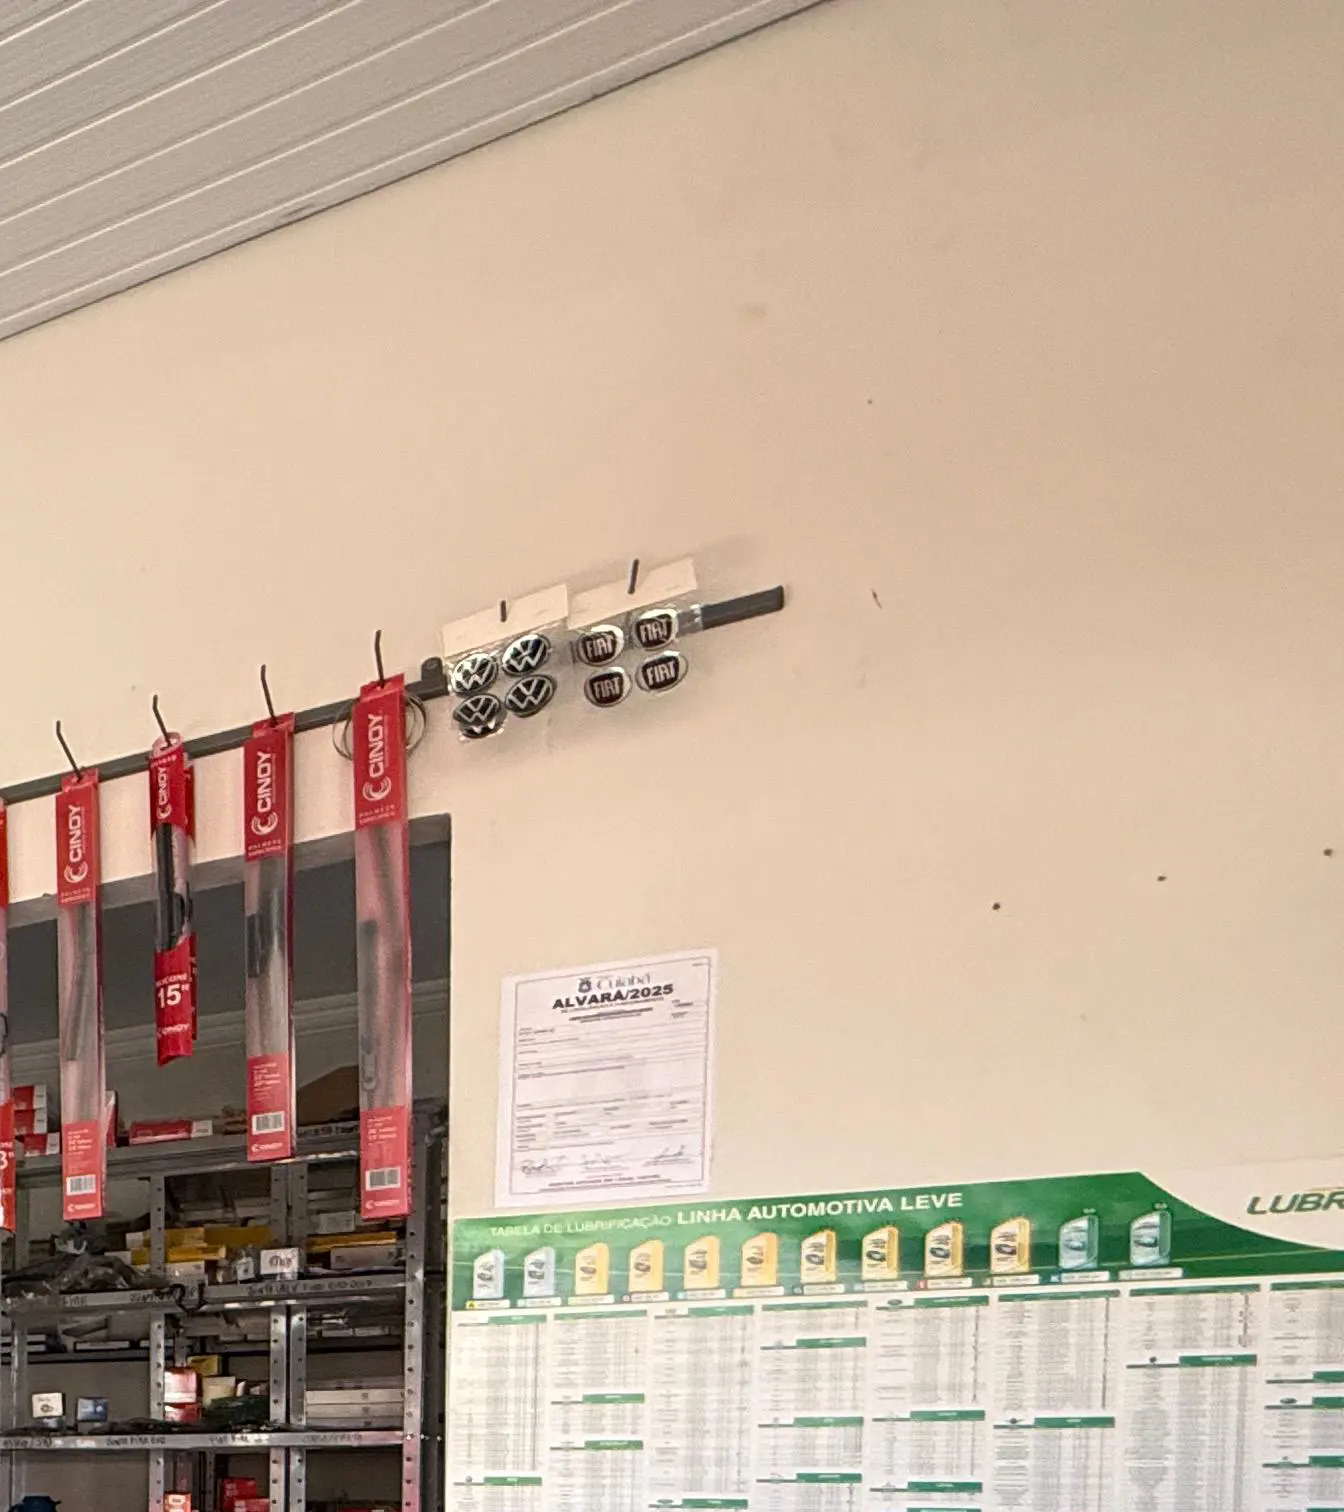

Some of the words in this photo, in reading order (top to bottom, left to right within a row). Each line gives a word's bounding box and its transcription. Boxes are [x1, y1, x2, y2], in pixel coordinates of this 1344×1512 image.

[585, 634, 615, 660] FIAT
[639, 618, 672, 643] FIAT
[593, 677, 621, 700] FIAT
[645, 662, 680, 686] FIAT
[368, 714, 385, 778] CINDY
[256, 751, 273, 813] CINDY
[69, 804, 83, 862] CINDY
[490, 1222, 540, 1236] TABELA
[544, 1223, 564, 1234] DE
[677, 1208, 742, 1225] LINHA
[747, 1197, 893, 1221] AUTOMOTIVA
[900, 1192, 964, 1211] LEVE
